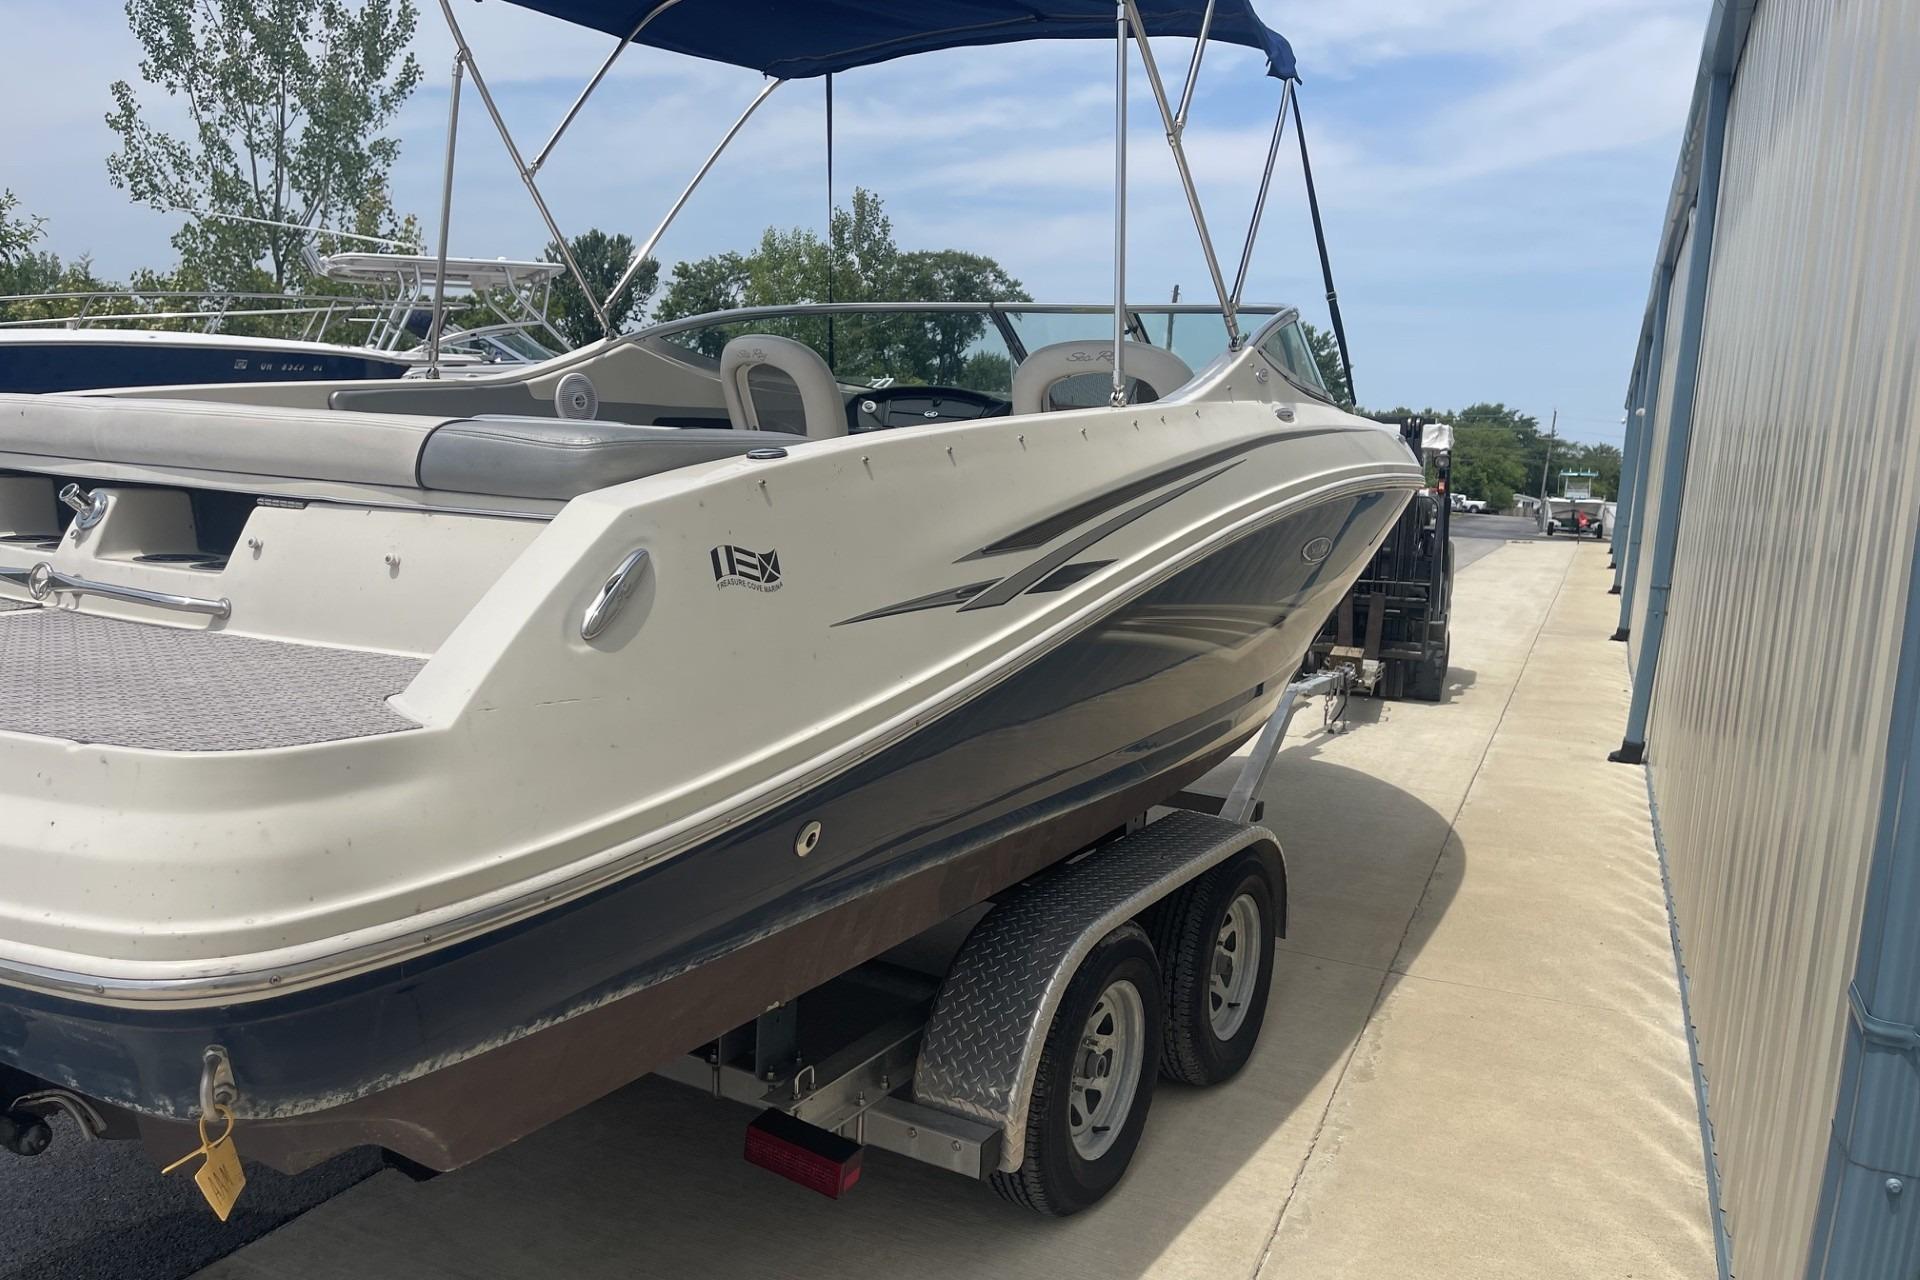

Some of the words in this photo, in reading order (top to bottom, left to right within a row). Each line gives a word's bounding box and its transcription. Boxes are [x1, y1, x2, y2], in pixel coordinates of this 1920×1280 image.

[1066, 351, 1092, 362] Sea
[1095, 350, 1115, 365] Ra
[717, 578, 746, 592] TREASURE
[747, 581, 764, 592] COVE
